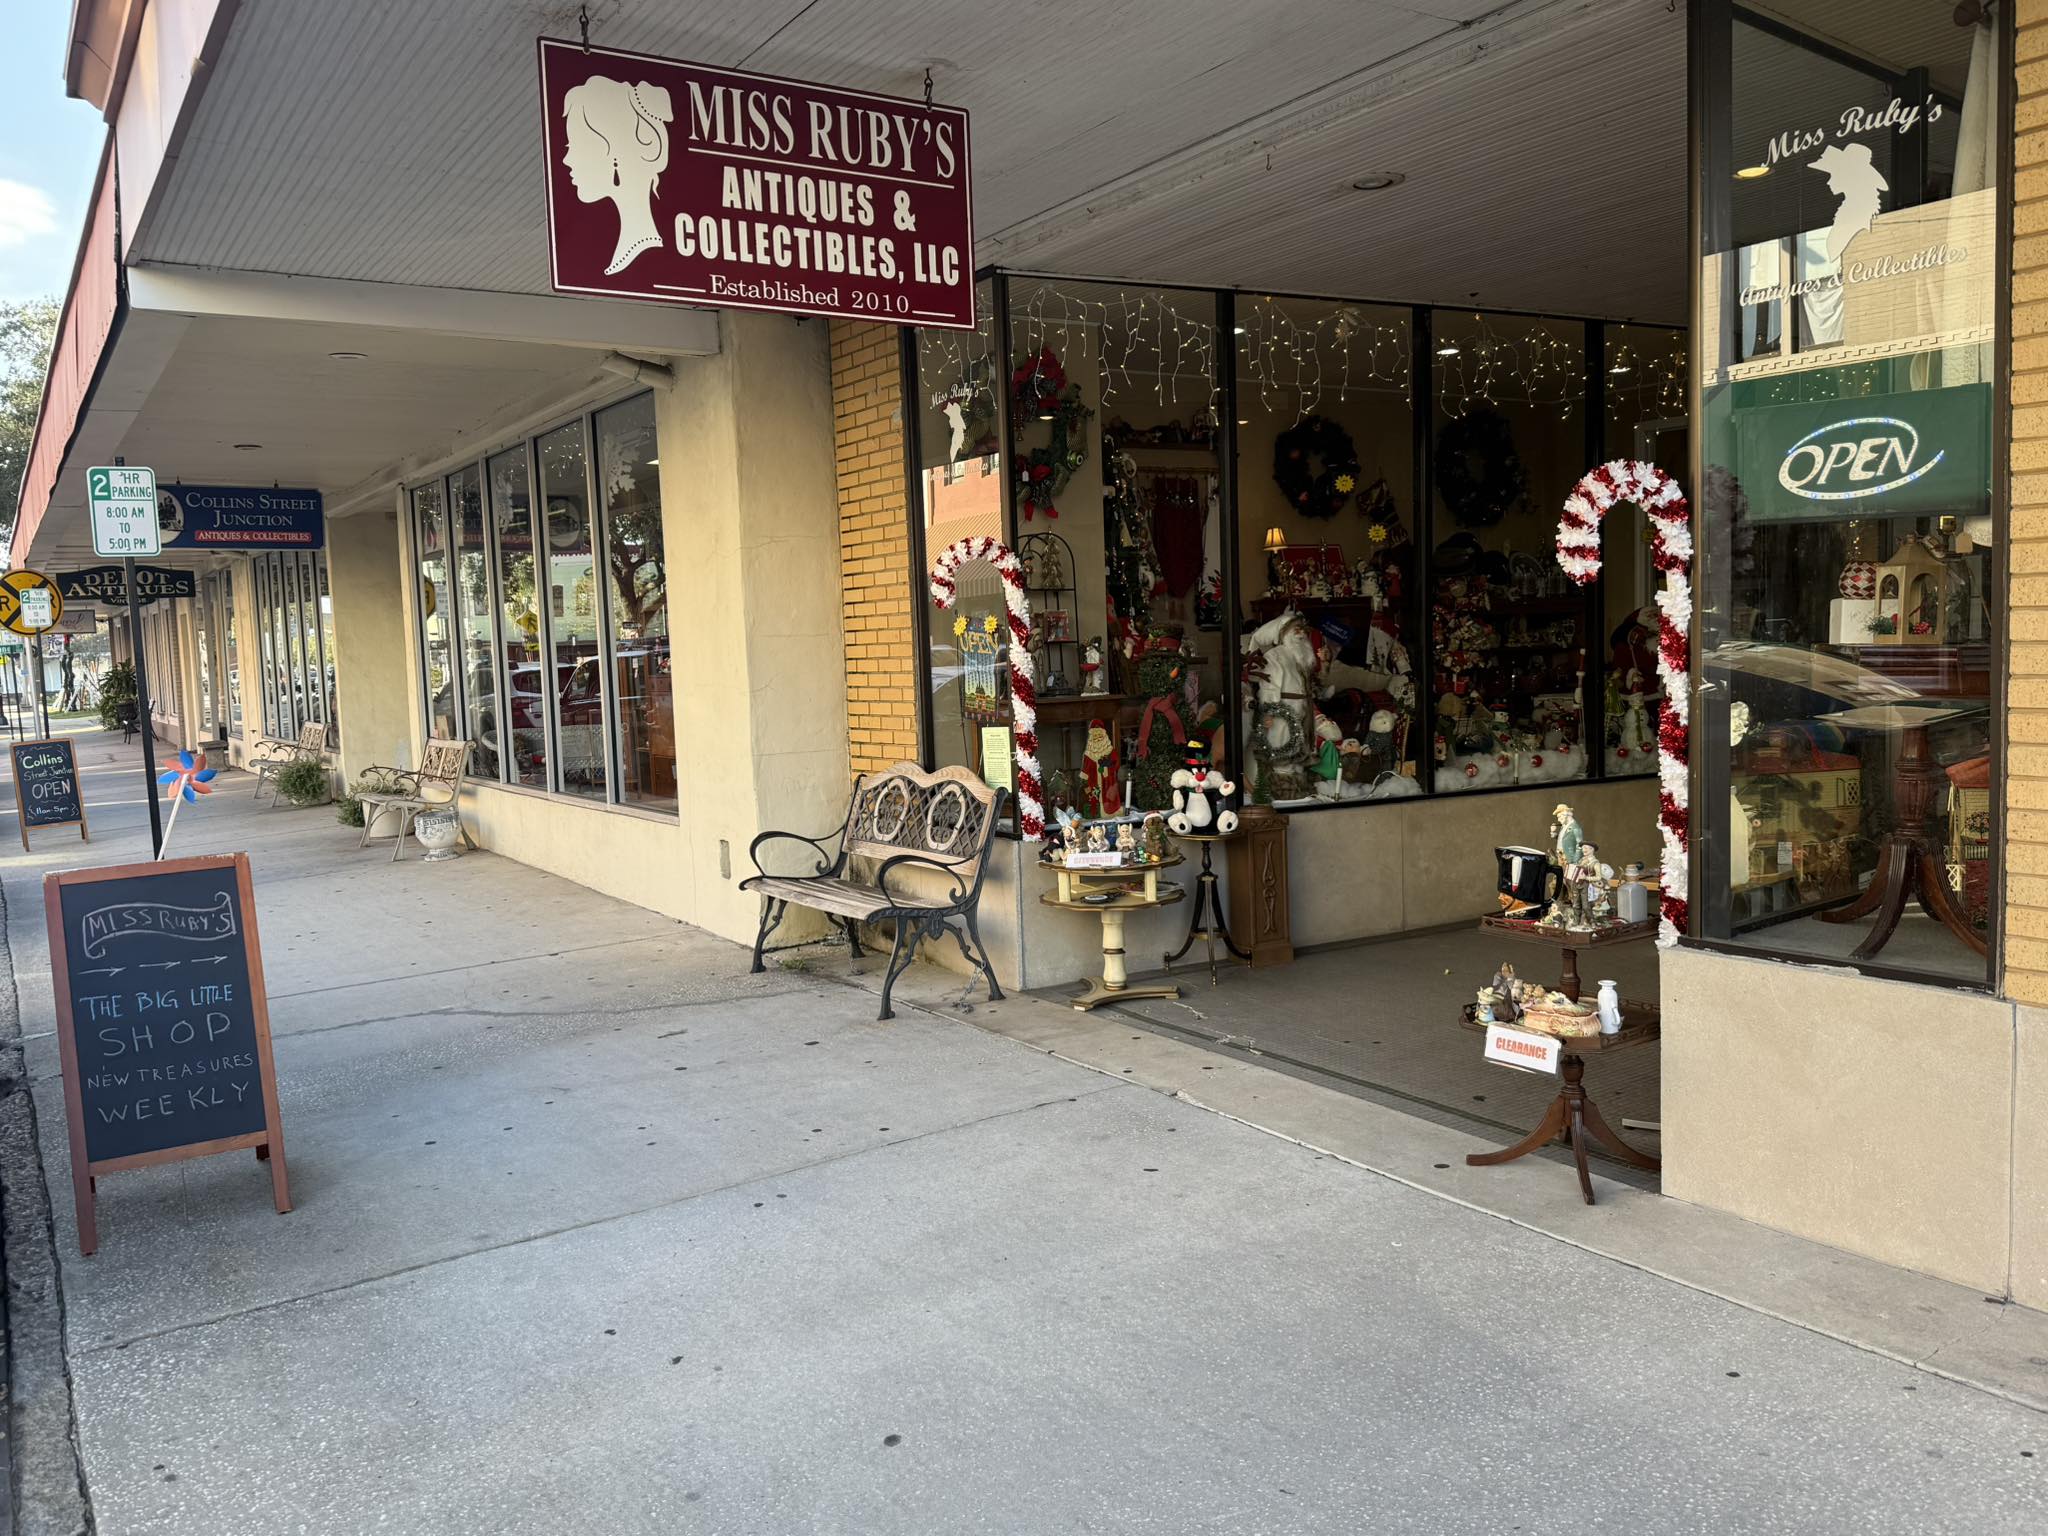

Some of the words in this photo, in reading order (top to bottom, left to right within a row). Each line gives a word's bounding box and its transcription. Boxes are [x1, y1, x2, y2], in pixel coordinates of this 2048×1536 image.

[686, 80, 795, 157] MISS
[806, 99, 956, 179] RUBY'S
[1761, 127, 1824, 168] Miss
[1836, 93, 1943, 138] Ruby's
[721, 165, 875, 227] ANTIQUES
[893, 190, 916, 232] &
[674, 212, 905, 284] COLLECTIBLES,
[913, 242, 960, 286] LLC
[1739, 278, 1822, 307] Antiques
[1849, 243, 1969, 283] Collectibles
[709, 273, 841, 308] Established
[851, 290, 910, 314] 2010
[930, 391, 948, 408] Miss
[950, 381, 980, 402] Ruby's
[1778, 437, 1912, 488] OPEN
[92, 474, 109, 496] 2
[124, 473, 140, 484] HR
[112, 486, 152, 498] PARKING
[185, 492, 255, 509] COLLINS
[260, 494, 317, 510] STREET
[106, 507, 128, 518] 8:00
[131, 507, 145, 518] AM
[213, 510, 293, 528] JUNCTION
[119, 522, 131, 533] TO
[198, 531, 241, 541] ANTIQUES
[242, 532, 251, 541] &
[252, 532, 310, 541] COLLECTIBLES
[109, 538, 131, 551] 5:00
[134, 538, 147, 549] PM
[22, 592, 30, 602] 2
[65, 580, 189, 597] ANTIUES
[22, 753, 63, 769] Collins
[24, 769, 48, 781] Street
[32, 779, 71, 799] OPEN
[88, 908, 152, 938] MISS
[159, 909, 233, 933] RUBY'S
[79, 994, 123, 1021] THE
[136, 989, 178, 1013] BIG
[190, 983, 233, 1007] LITTLE
[98, 1012, 231, 1056] SHOP
[1495, 1036, 1548, 1061] CLEARANCE
[87, 1070, 129, 1089] NEW
[136, 1052, 254, 1082] TREASURES
[98, 1081, 249, 1124] WEEKLY
